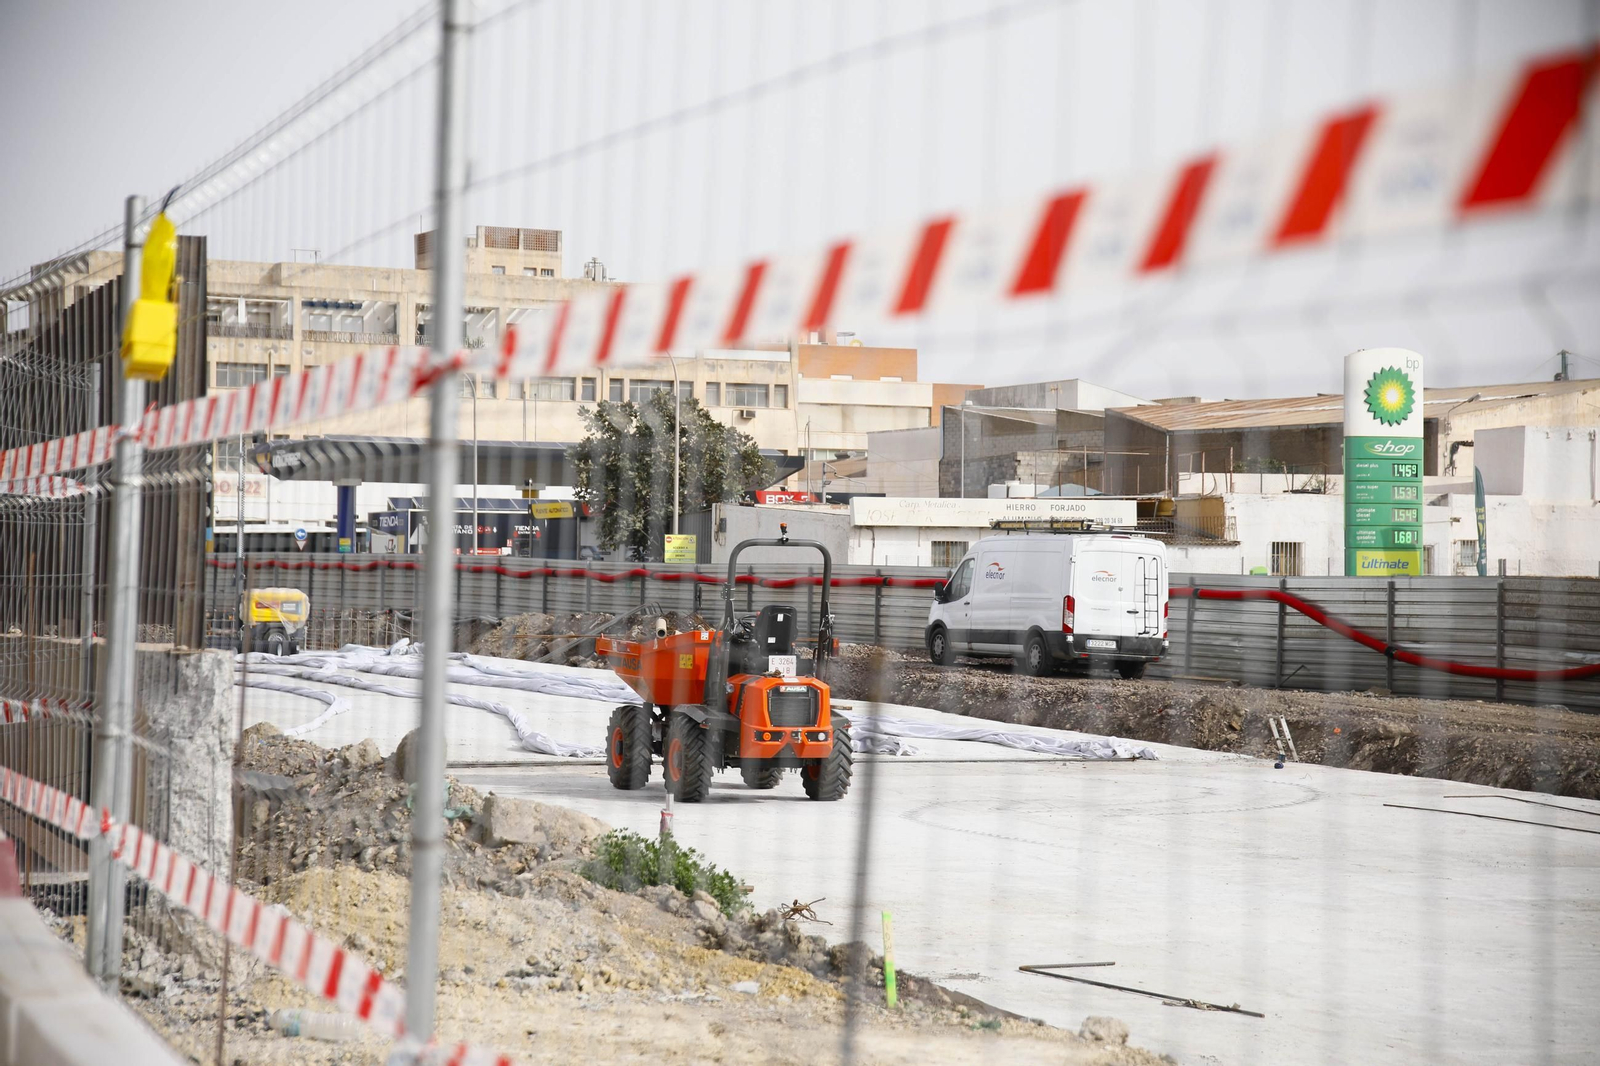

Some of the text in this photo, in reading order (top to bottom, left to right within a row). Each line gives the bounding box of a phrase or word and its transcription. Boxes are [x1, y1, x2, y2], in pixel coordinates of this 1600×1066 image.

[1406, 356, 1420, 372] bp
[1373, 440, 1415, 456] shop
[1006, 503, 1086, 512] HIERRO FORJADO
[379, 515, 399, 527] TIENDA
[1361, 558, 1409, 570] ultimate
[986, 569, 1005, 580] elecnor
[1091, 575, 1117, 583] elecnor
